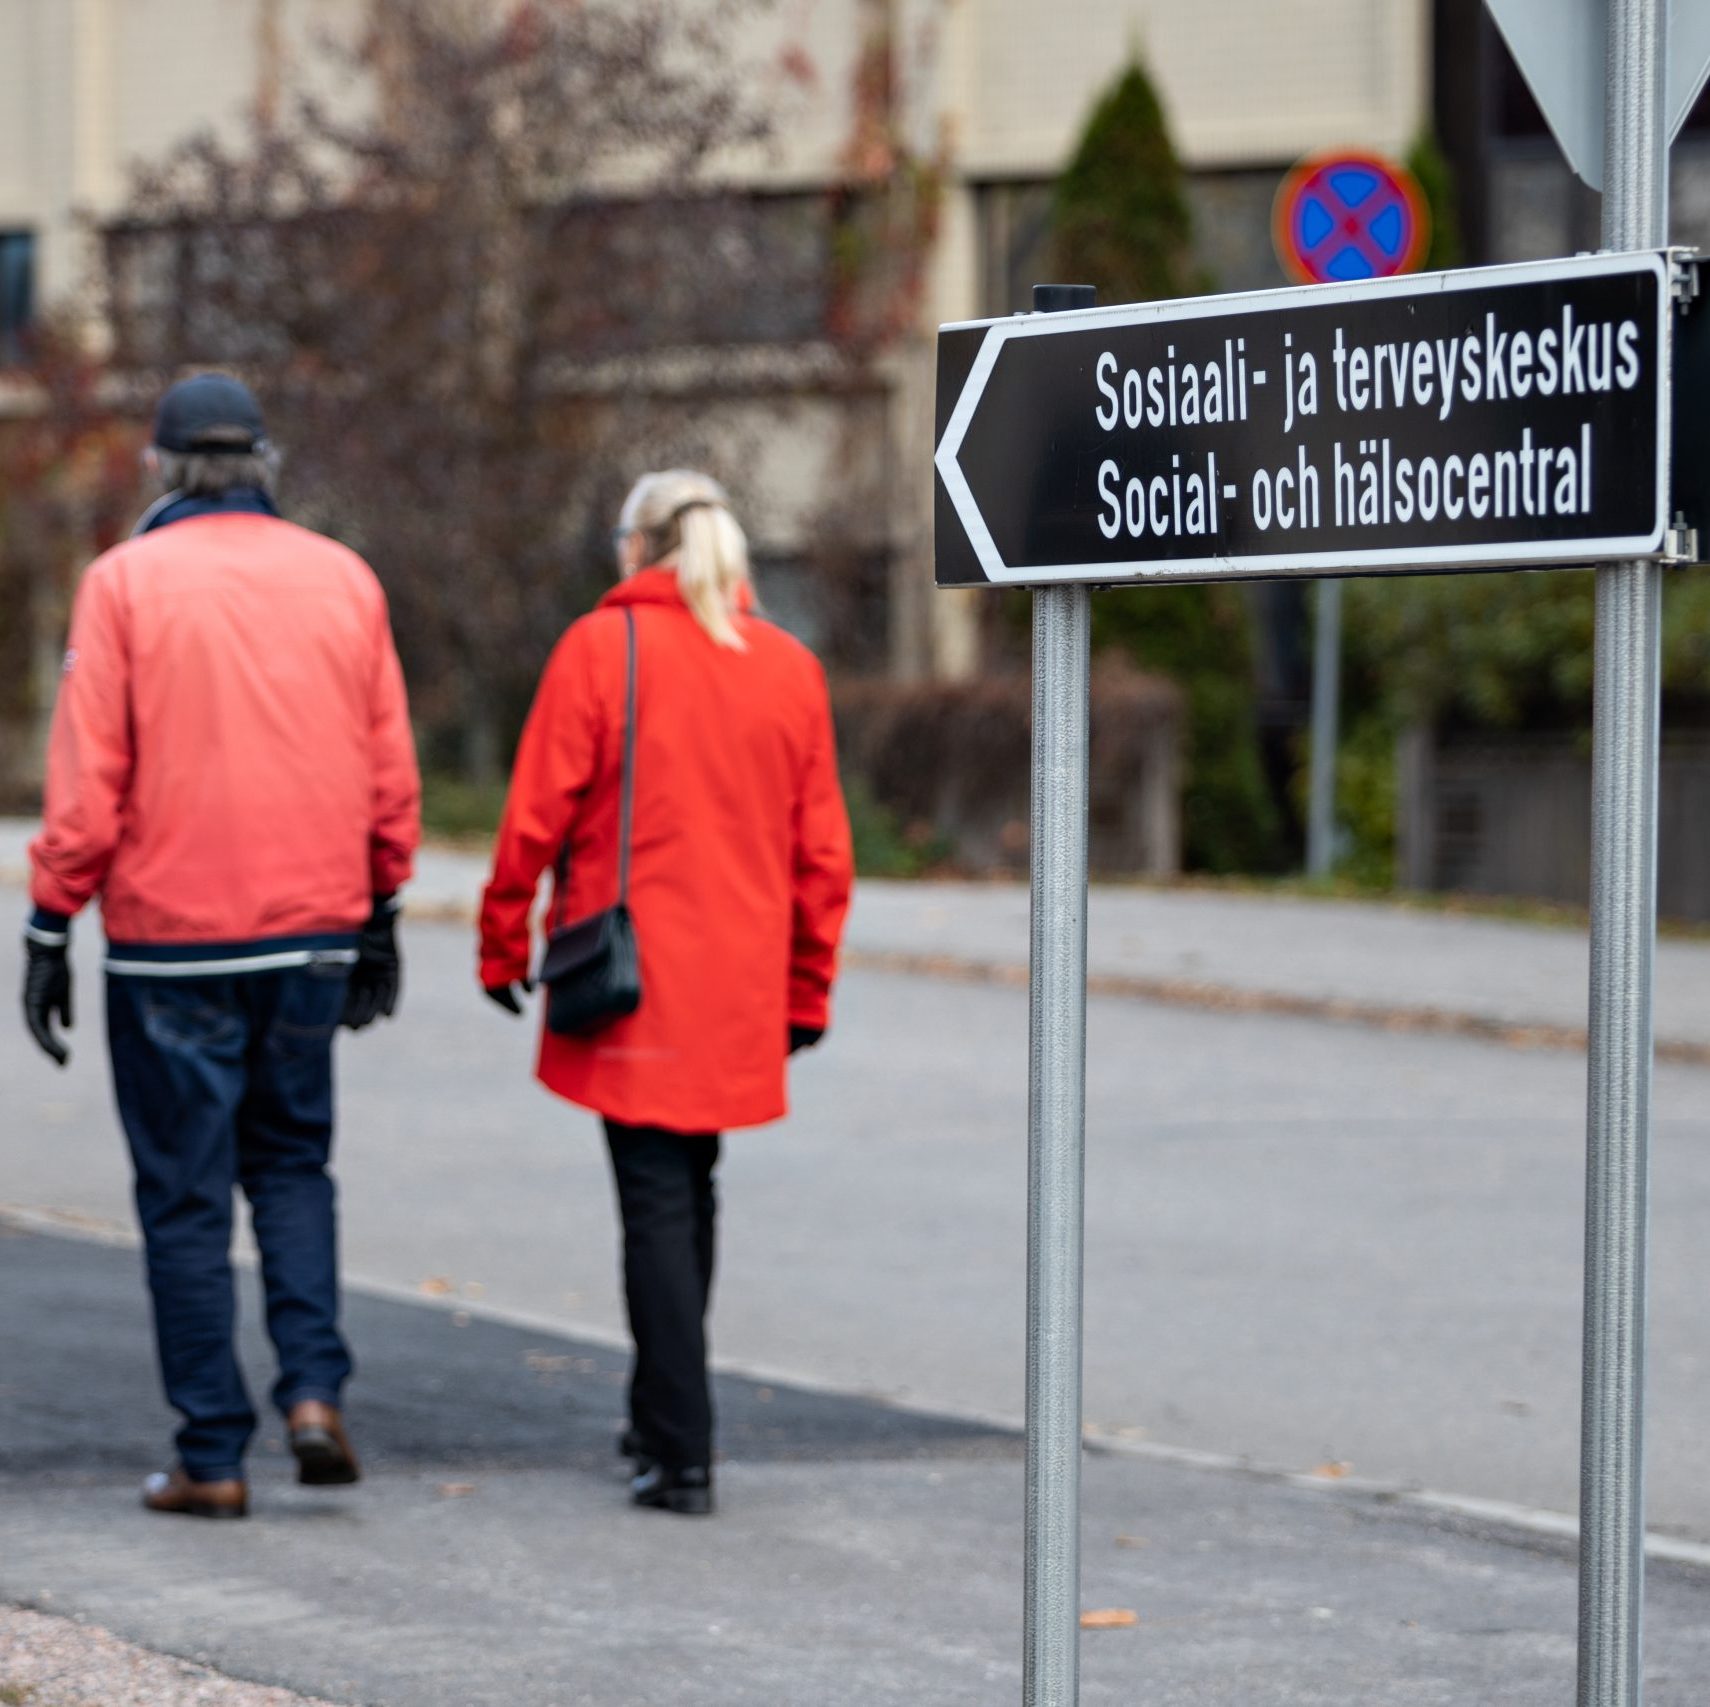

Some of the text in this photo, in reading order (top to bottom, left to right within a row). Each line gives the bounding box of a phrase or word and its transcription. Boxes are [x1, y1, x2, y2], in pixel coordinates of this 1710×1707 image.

[1095, 304, 1640, 433] Sosiaali- ja terveyskeskus
[1097, 423, 1591, 539] Social- och hälsocentral
